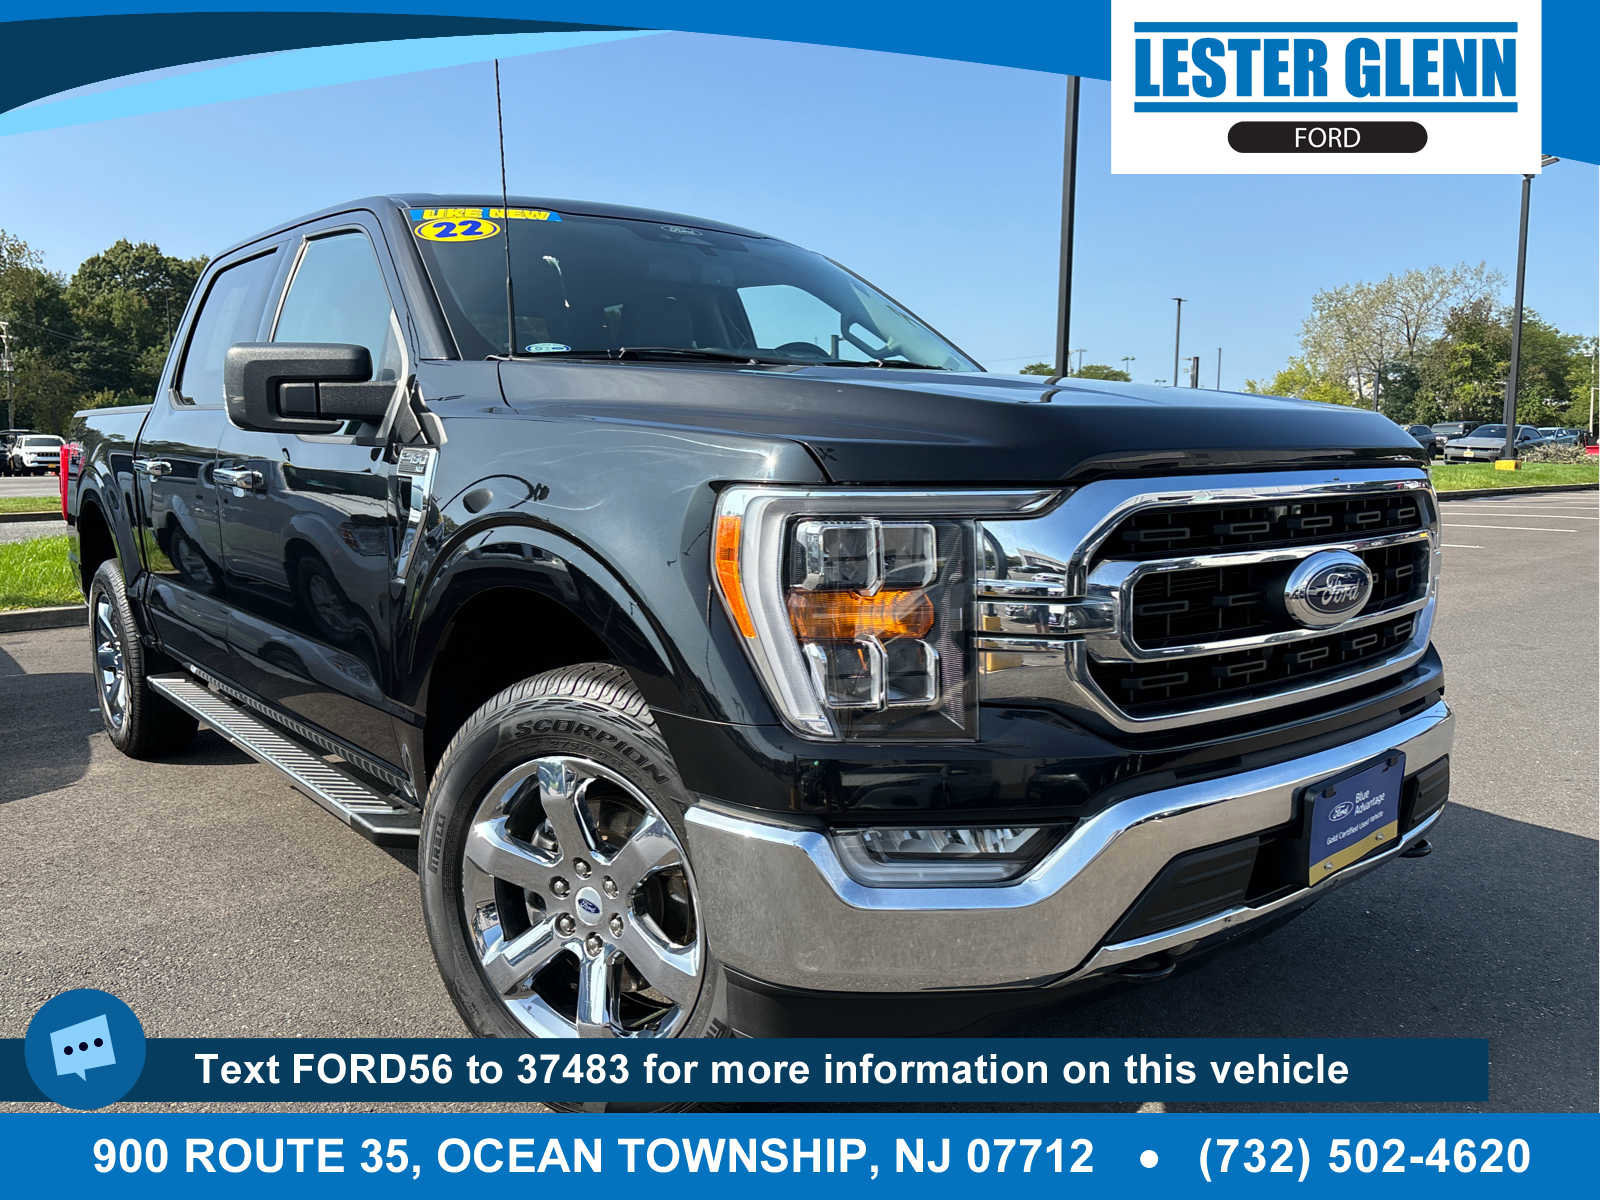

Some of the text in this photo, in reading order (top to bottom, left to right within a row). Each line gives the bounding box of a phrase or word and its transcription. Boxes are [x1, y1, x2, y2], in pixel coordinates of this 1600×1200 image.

[422, 208, 550, 221] LIKE NEW
[432, 220, 483, 238] 22
[1321, 572, 1361, 606] Ford
[515, 719, 670, 785] SCORPION
[1354, 792, 1386, 816] Advantage
[1355, 790, 1370, 804] Blue
